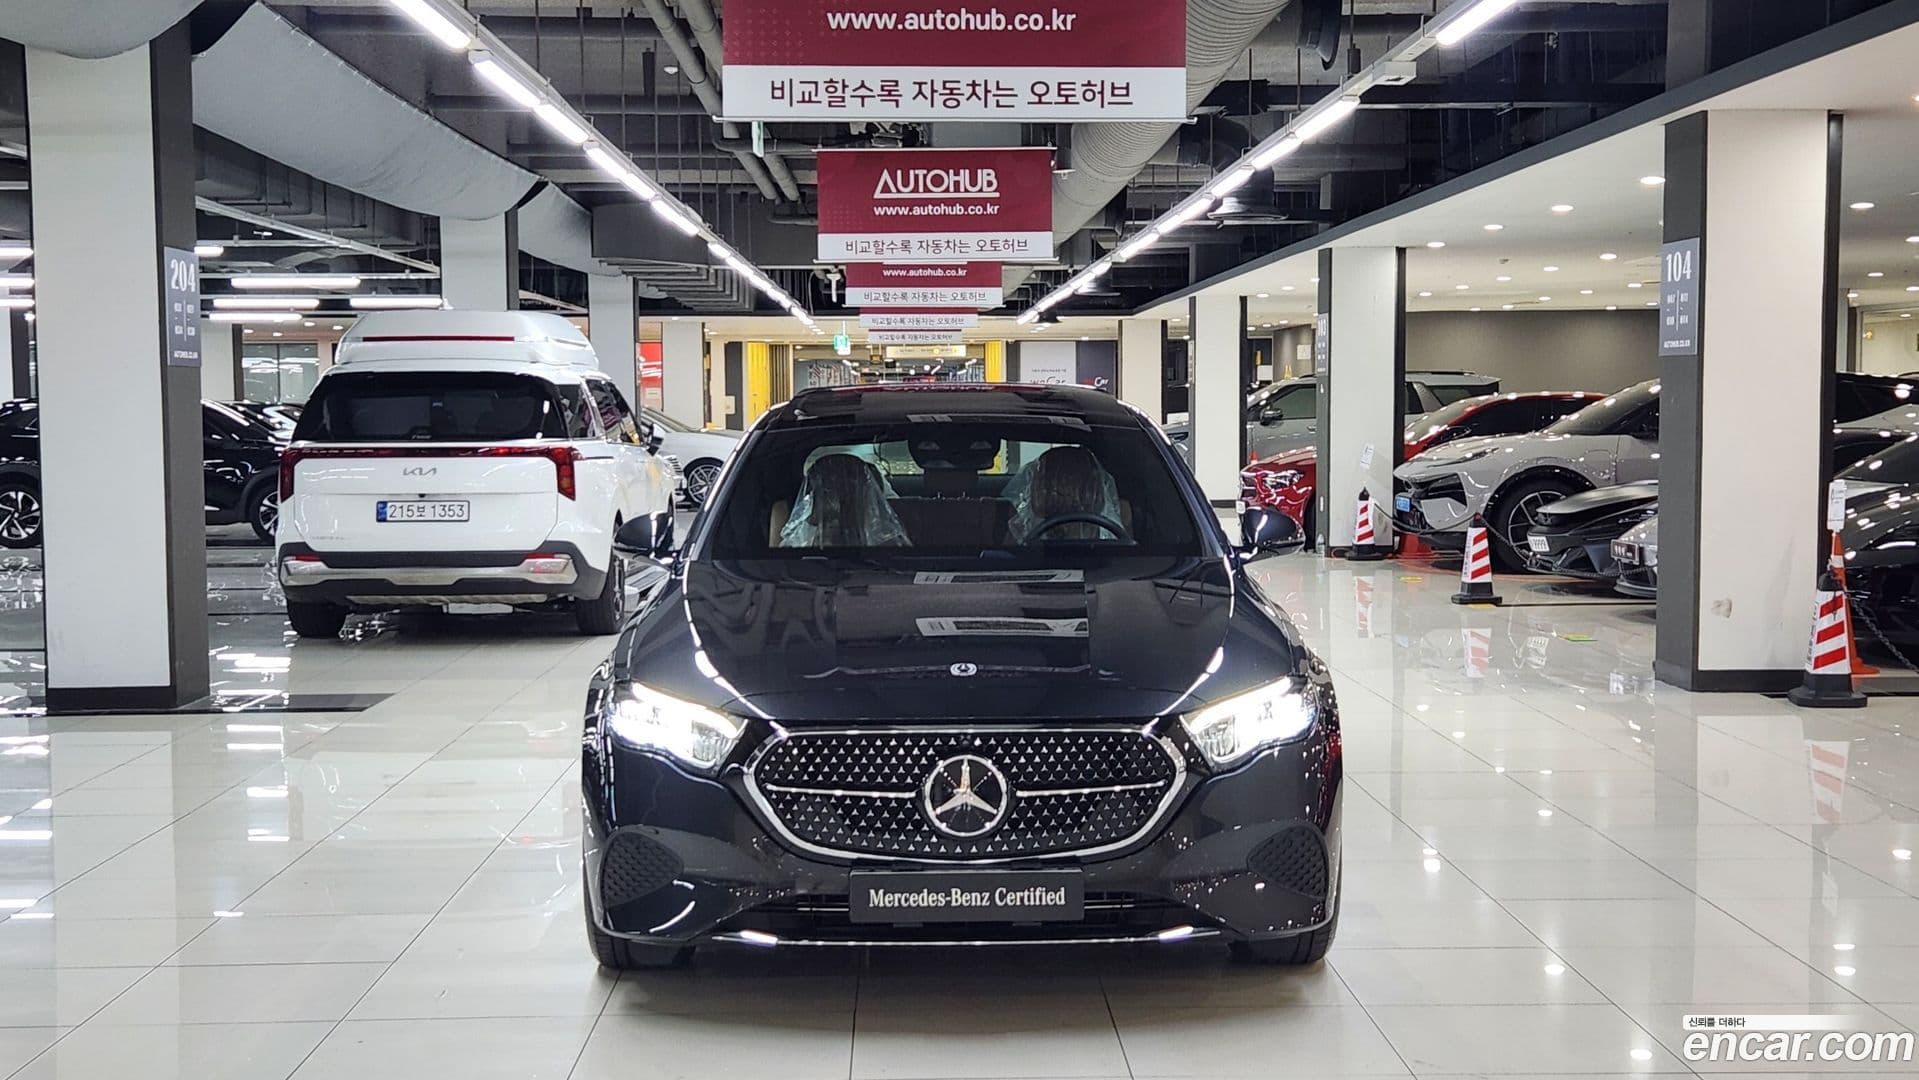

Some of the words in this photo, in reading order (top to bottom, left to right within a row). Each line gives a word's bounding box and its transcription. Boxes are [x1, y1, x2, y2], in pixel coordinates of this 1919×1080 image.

[827, 7, 1076, 31] www.autohub.co.kr
[770, 78, 903, 109] 비교할수록
[911, 78, 1018, 110] 자동차는
[1026, 79, 1134, 109] 오토허브
[873, 168, 1000, 198] AUTOHUB
[873, 203, 1000, 217] www.autohub.co.kr
[845, 238, 912, 255] 비교할수록
[916, 238, 971, 255] 자동차는
[975, 238, 1029, 254] 오토허브
[170, 258, 196, 293] 204
[882, 267, 968, 278] www.autohub.co.kr
[1665, 249, 1692, 283] 104
[863, 291, 909, 303] 비교할수록
[911, 291, 949, 303] 자동차는
[951, 291, 987, 303] 오토허브
[388, 503, 426, 519] 215보
[430, 503, 465, 518] 1353
[869, 888, 991, 908] Mercedes-Benz
[994, 886, 1066, 906] Certified
